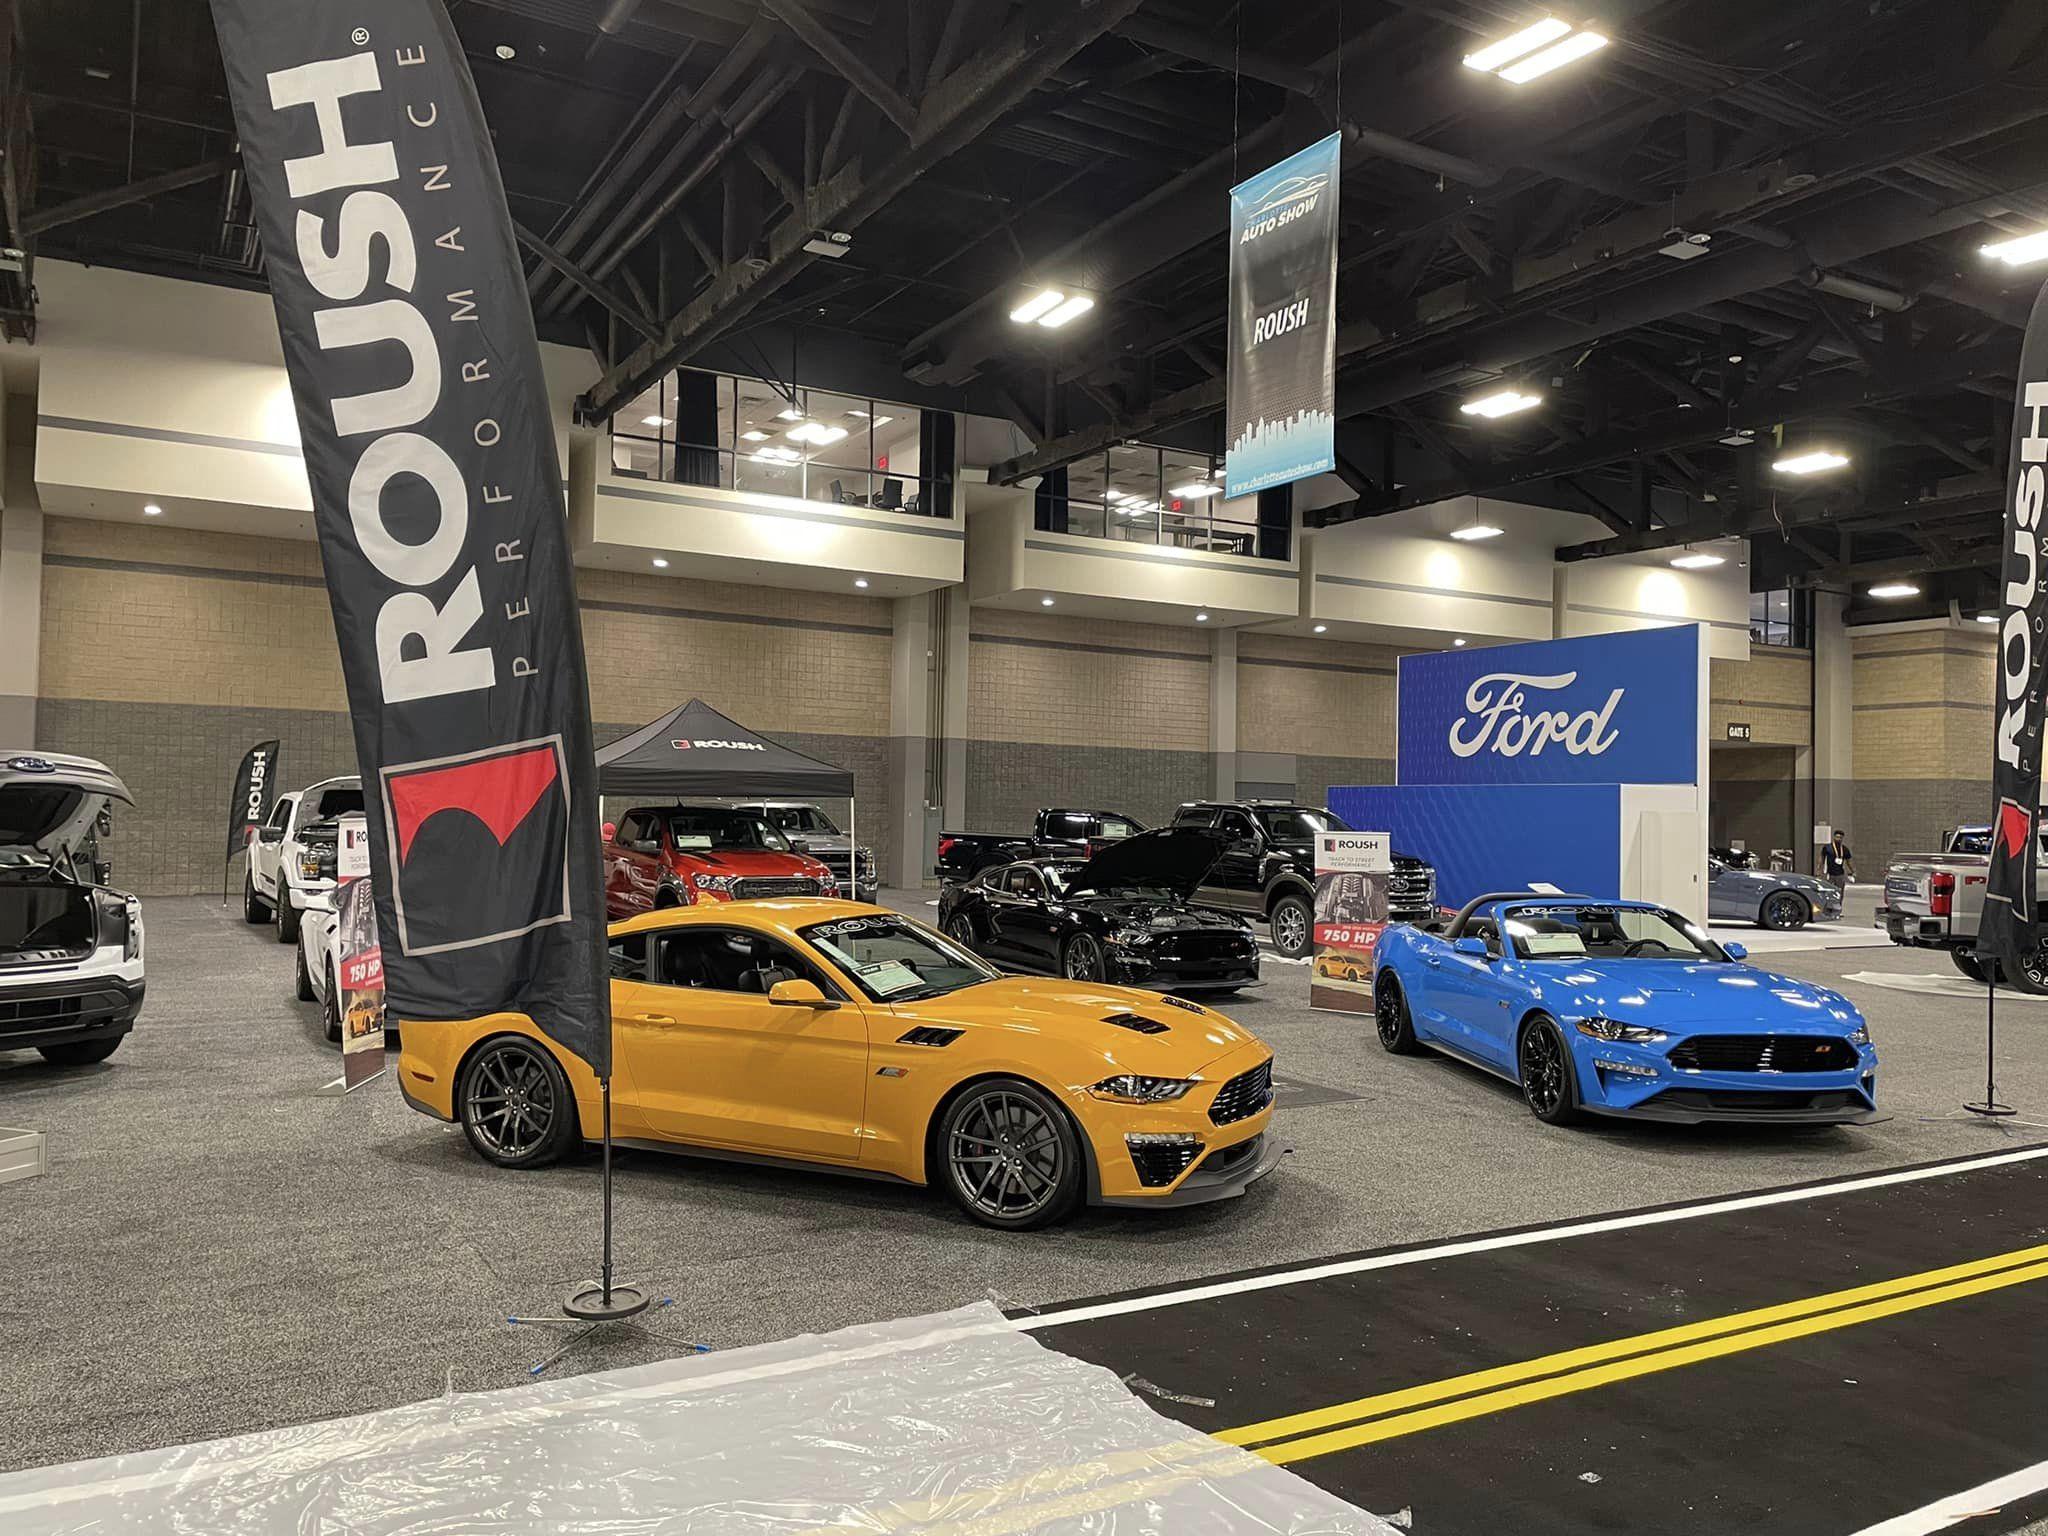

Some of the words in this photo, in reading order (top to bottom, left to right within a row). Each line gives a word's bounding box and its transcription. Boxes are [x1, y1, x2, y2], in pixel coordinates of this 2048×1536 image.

[1240, 217, 1276, 245] AUTO
[1277, 194, 1320, 227] SHOW
[1253, 297, 1310, 345] ROUSH
[266, 51, 497, 704] ROUSH
[396, 44, 539, 679] PERFORMANCE
[1999, 381, 2048, 770] ROUSH
[2022, 497, 2048, 772] PERFORM
[1449, 671, 1625, 757] Ford
[1728, 726, 1744, 738] GATE
[692, 739, 767, 751] ROUSH
[247, 751, 266, 820] ROUSH
[1338, 840, 1378, 850] ROUSH
[1324, 930, 1351, 943] 750
[1354, 932, 1377, 945] HP
[350, 962, 367, 984] 750
[368, 959, 380, 977] HP
